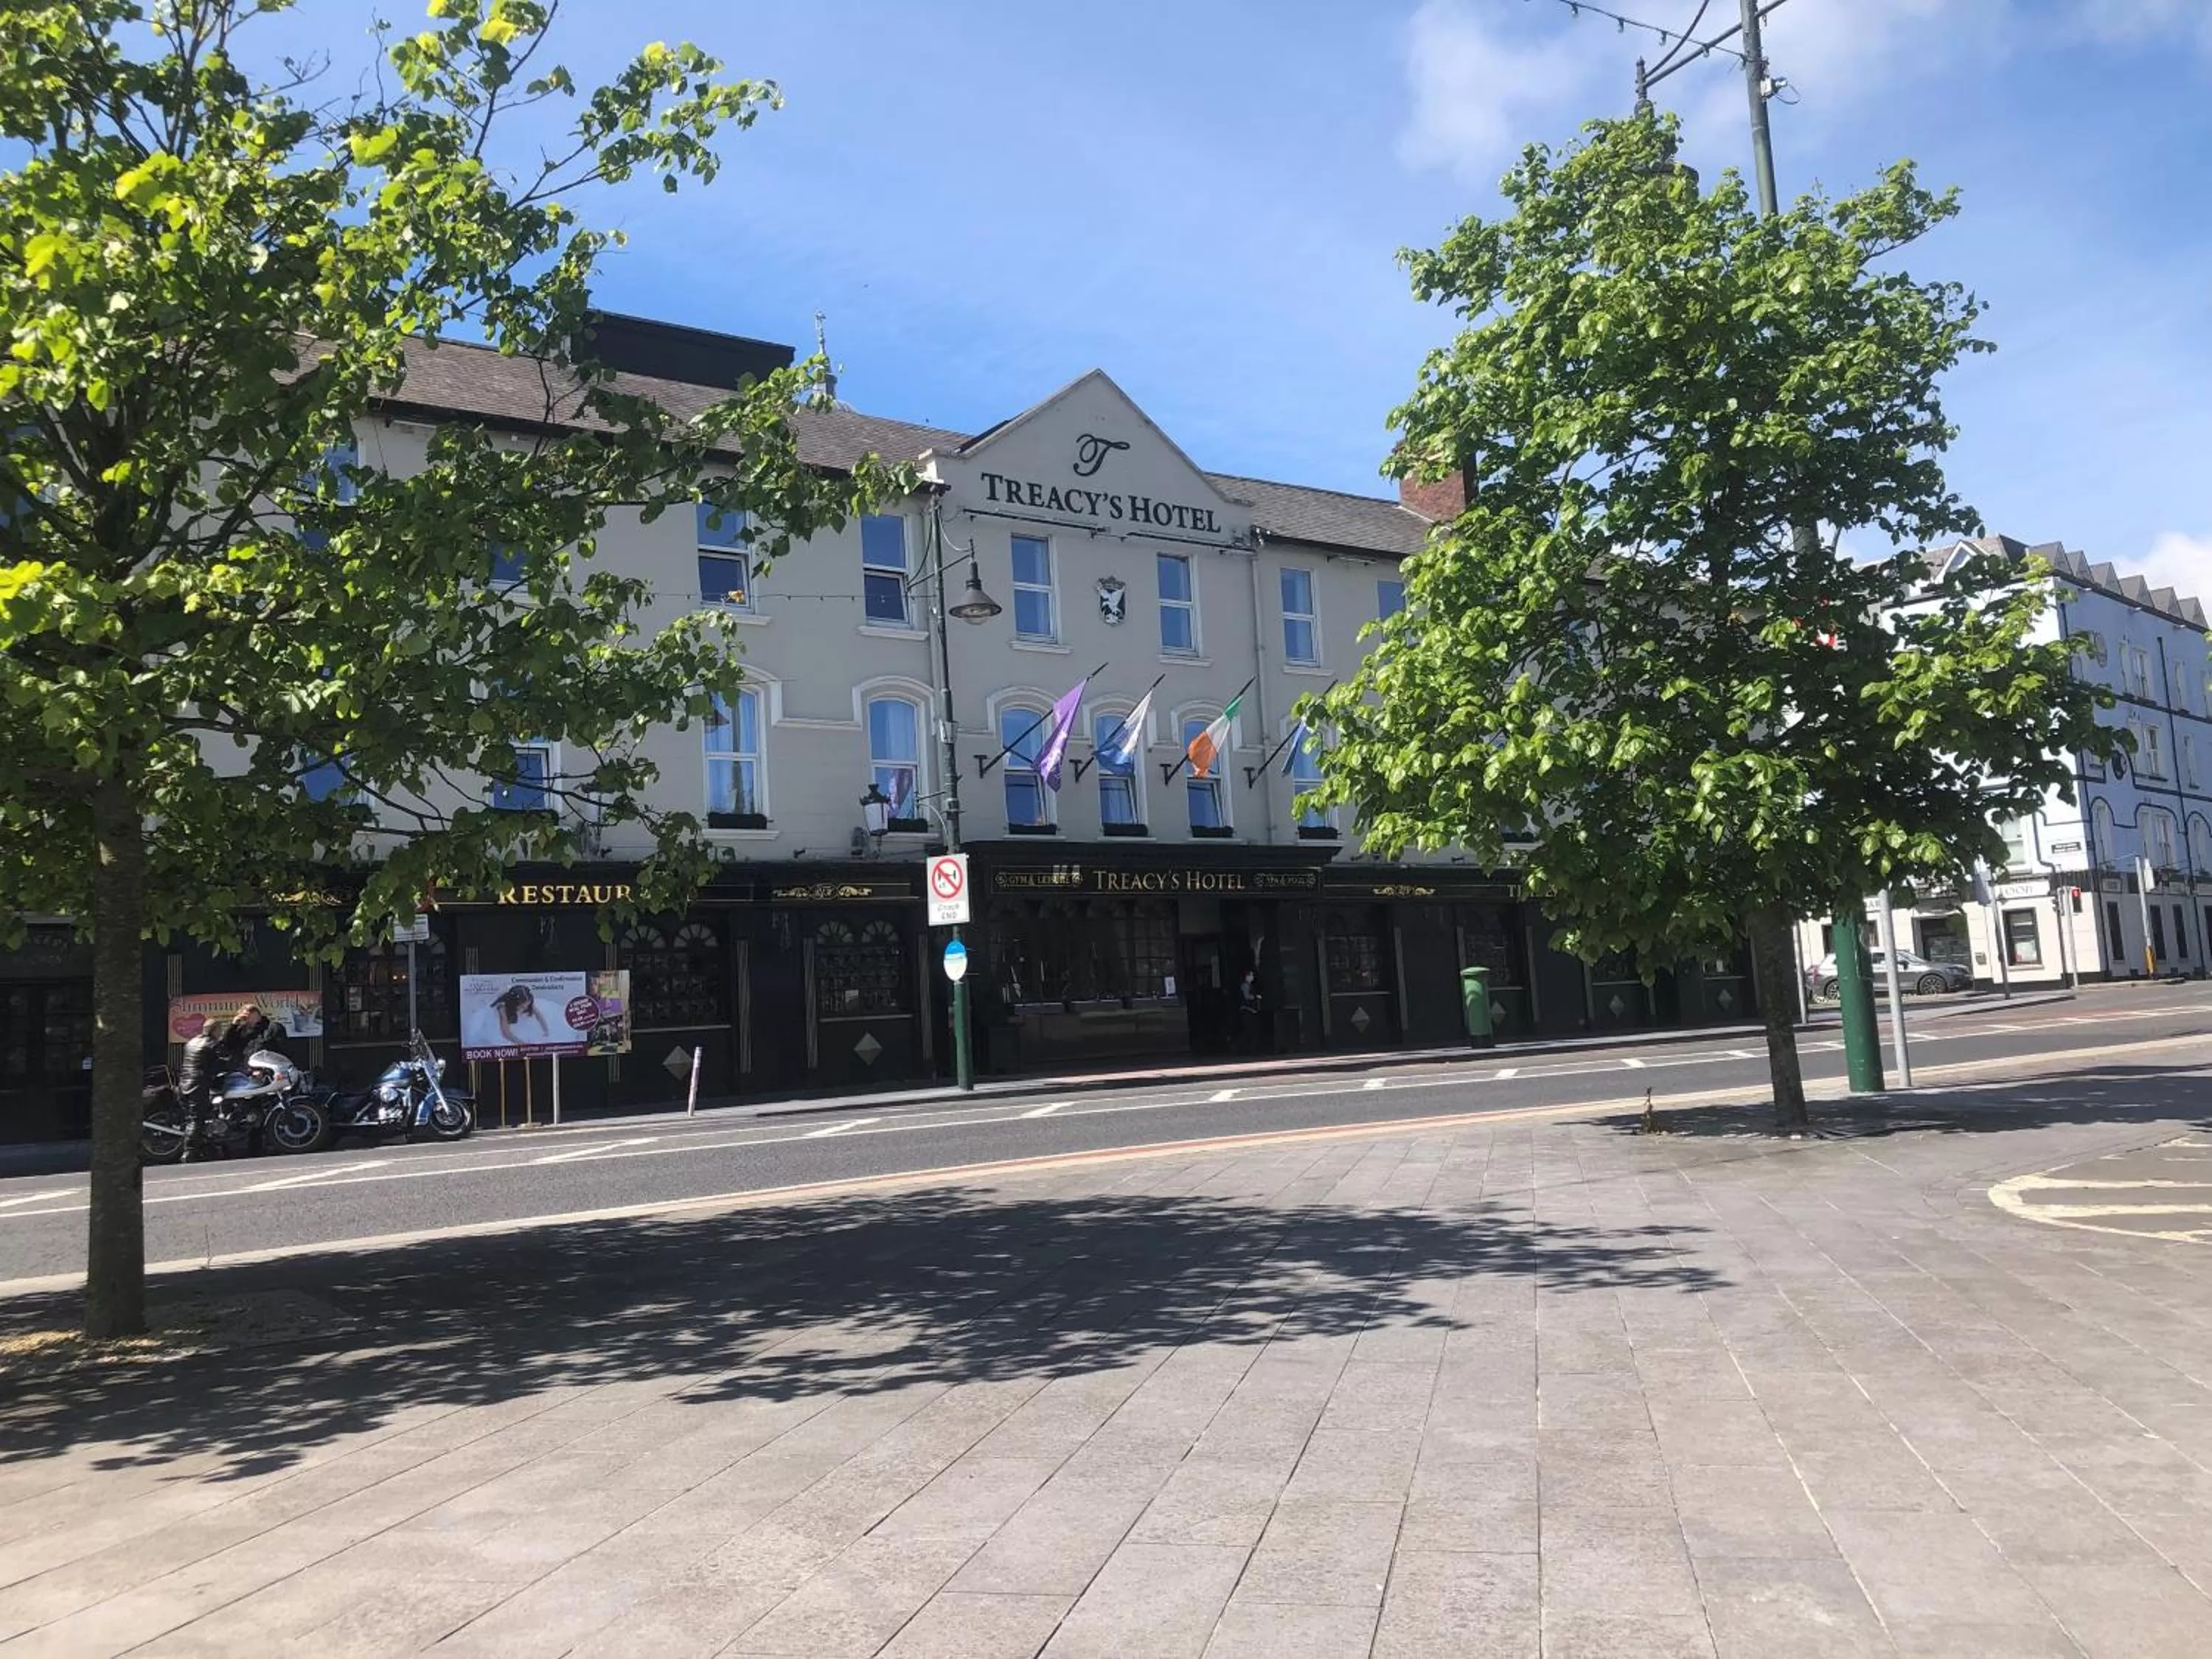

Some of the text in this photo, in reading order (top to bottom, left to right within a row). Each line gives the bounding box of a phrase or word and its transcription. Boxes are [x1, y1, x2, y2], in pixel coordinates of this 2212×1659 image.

[981, 472, 1222, 533] TREACY'S HOTEL
[1093, 870, 1245, 891] TREACY'S HOTEL
[498, 885, 652, 905] RESTAUR
[169, 995, 252, 1015] Slimmin
[466, 1049, 493, 1060] BOOK
[494, 1048, 518, 1058] NOW!
